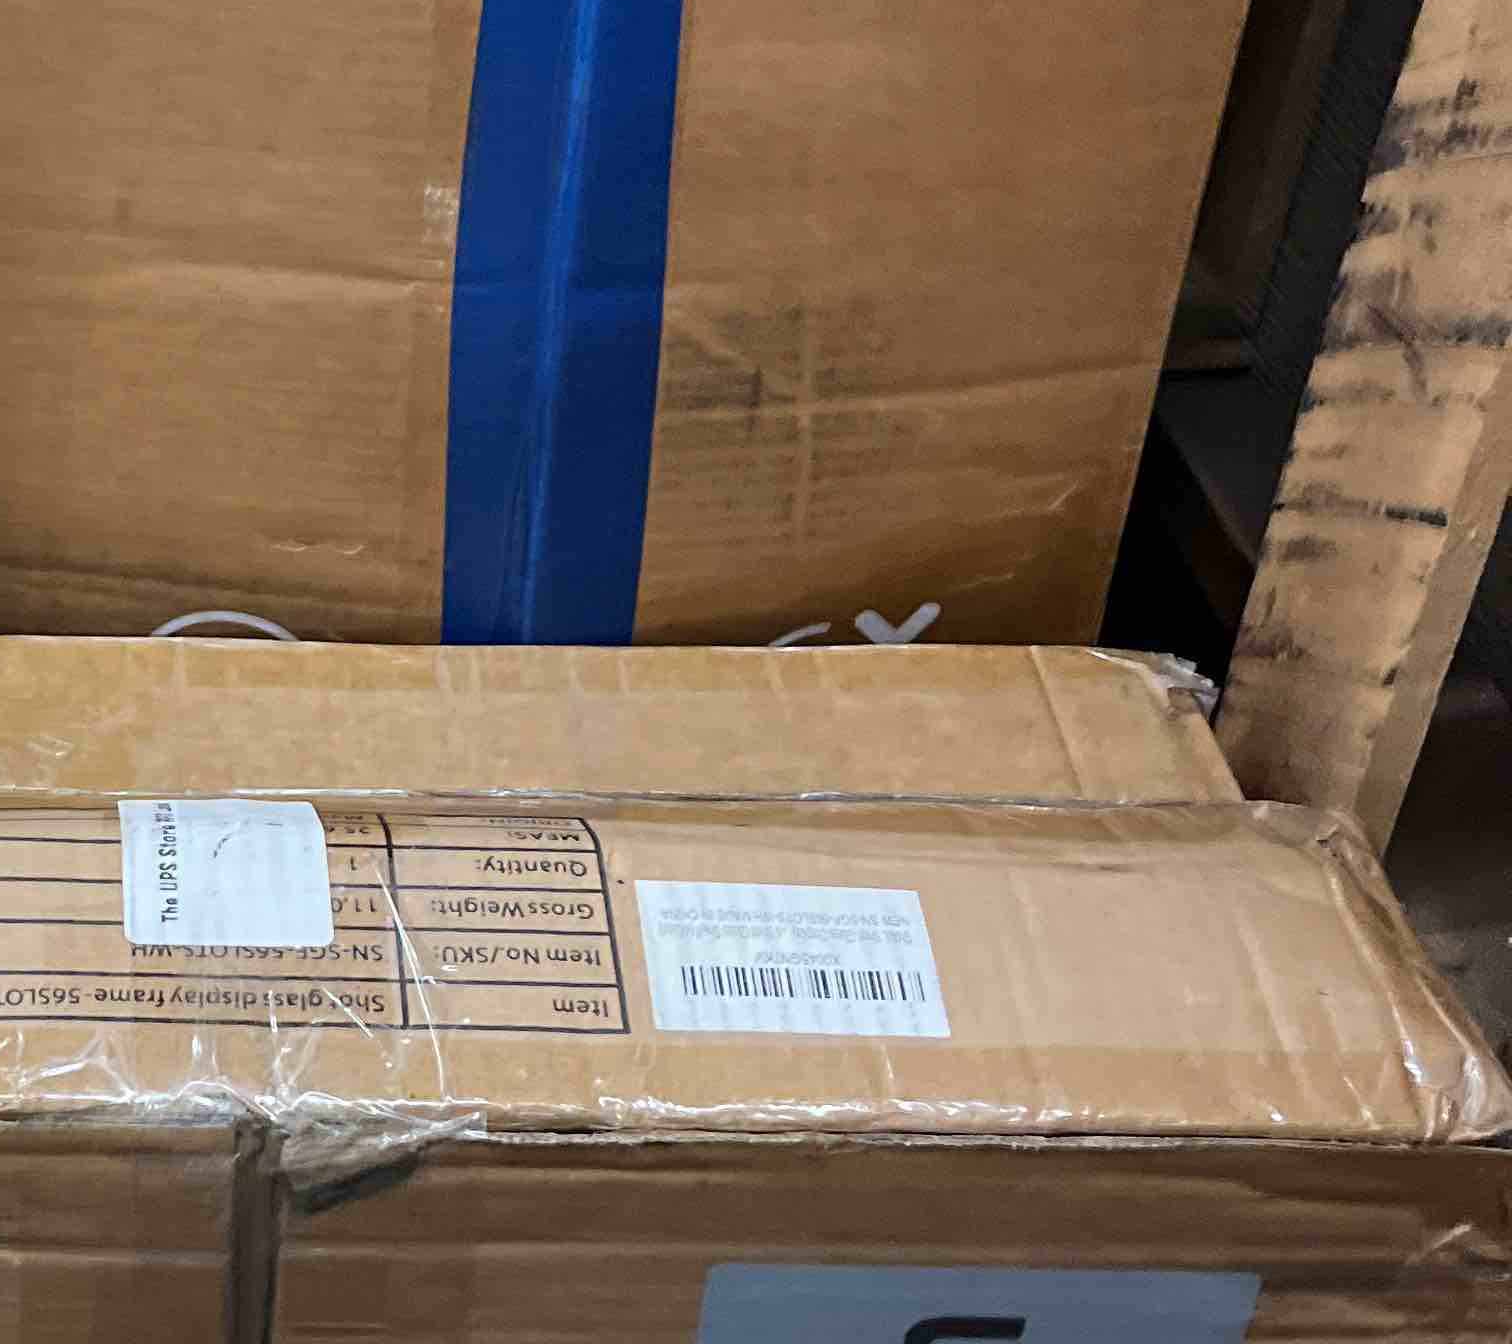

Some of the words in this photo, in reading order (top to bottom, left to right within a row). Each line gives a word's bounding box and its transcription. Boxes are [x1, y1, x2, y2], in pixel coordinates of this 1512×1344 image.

[349, 856, 358, 872] 1
[474, 857, 588, 878] Quantity:
[159, 862, 178, 891] UPS
[160, 898, 179, 922] The
[429, 897, 525, 918] Weight:
[527, 902, 595, 920] Gross
[545, 946, 602, 966] Item
[169, 986, 258, 1012] display
[552, 998, 610, 1019] Item
